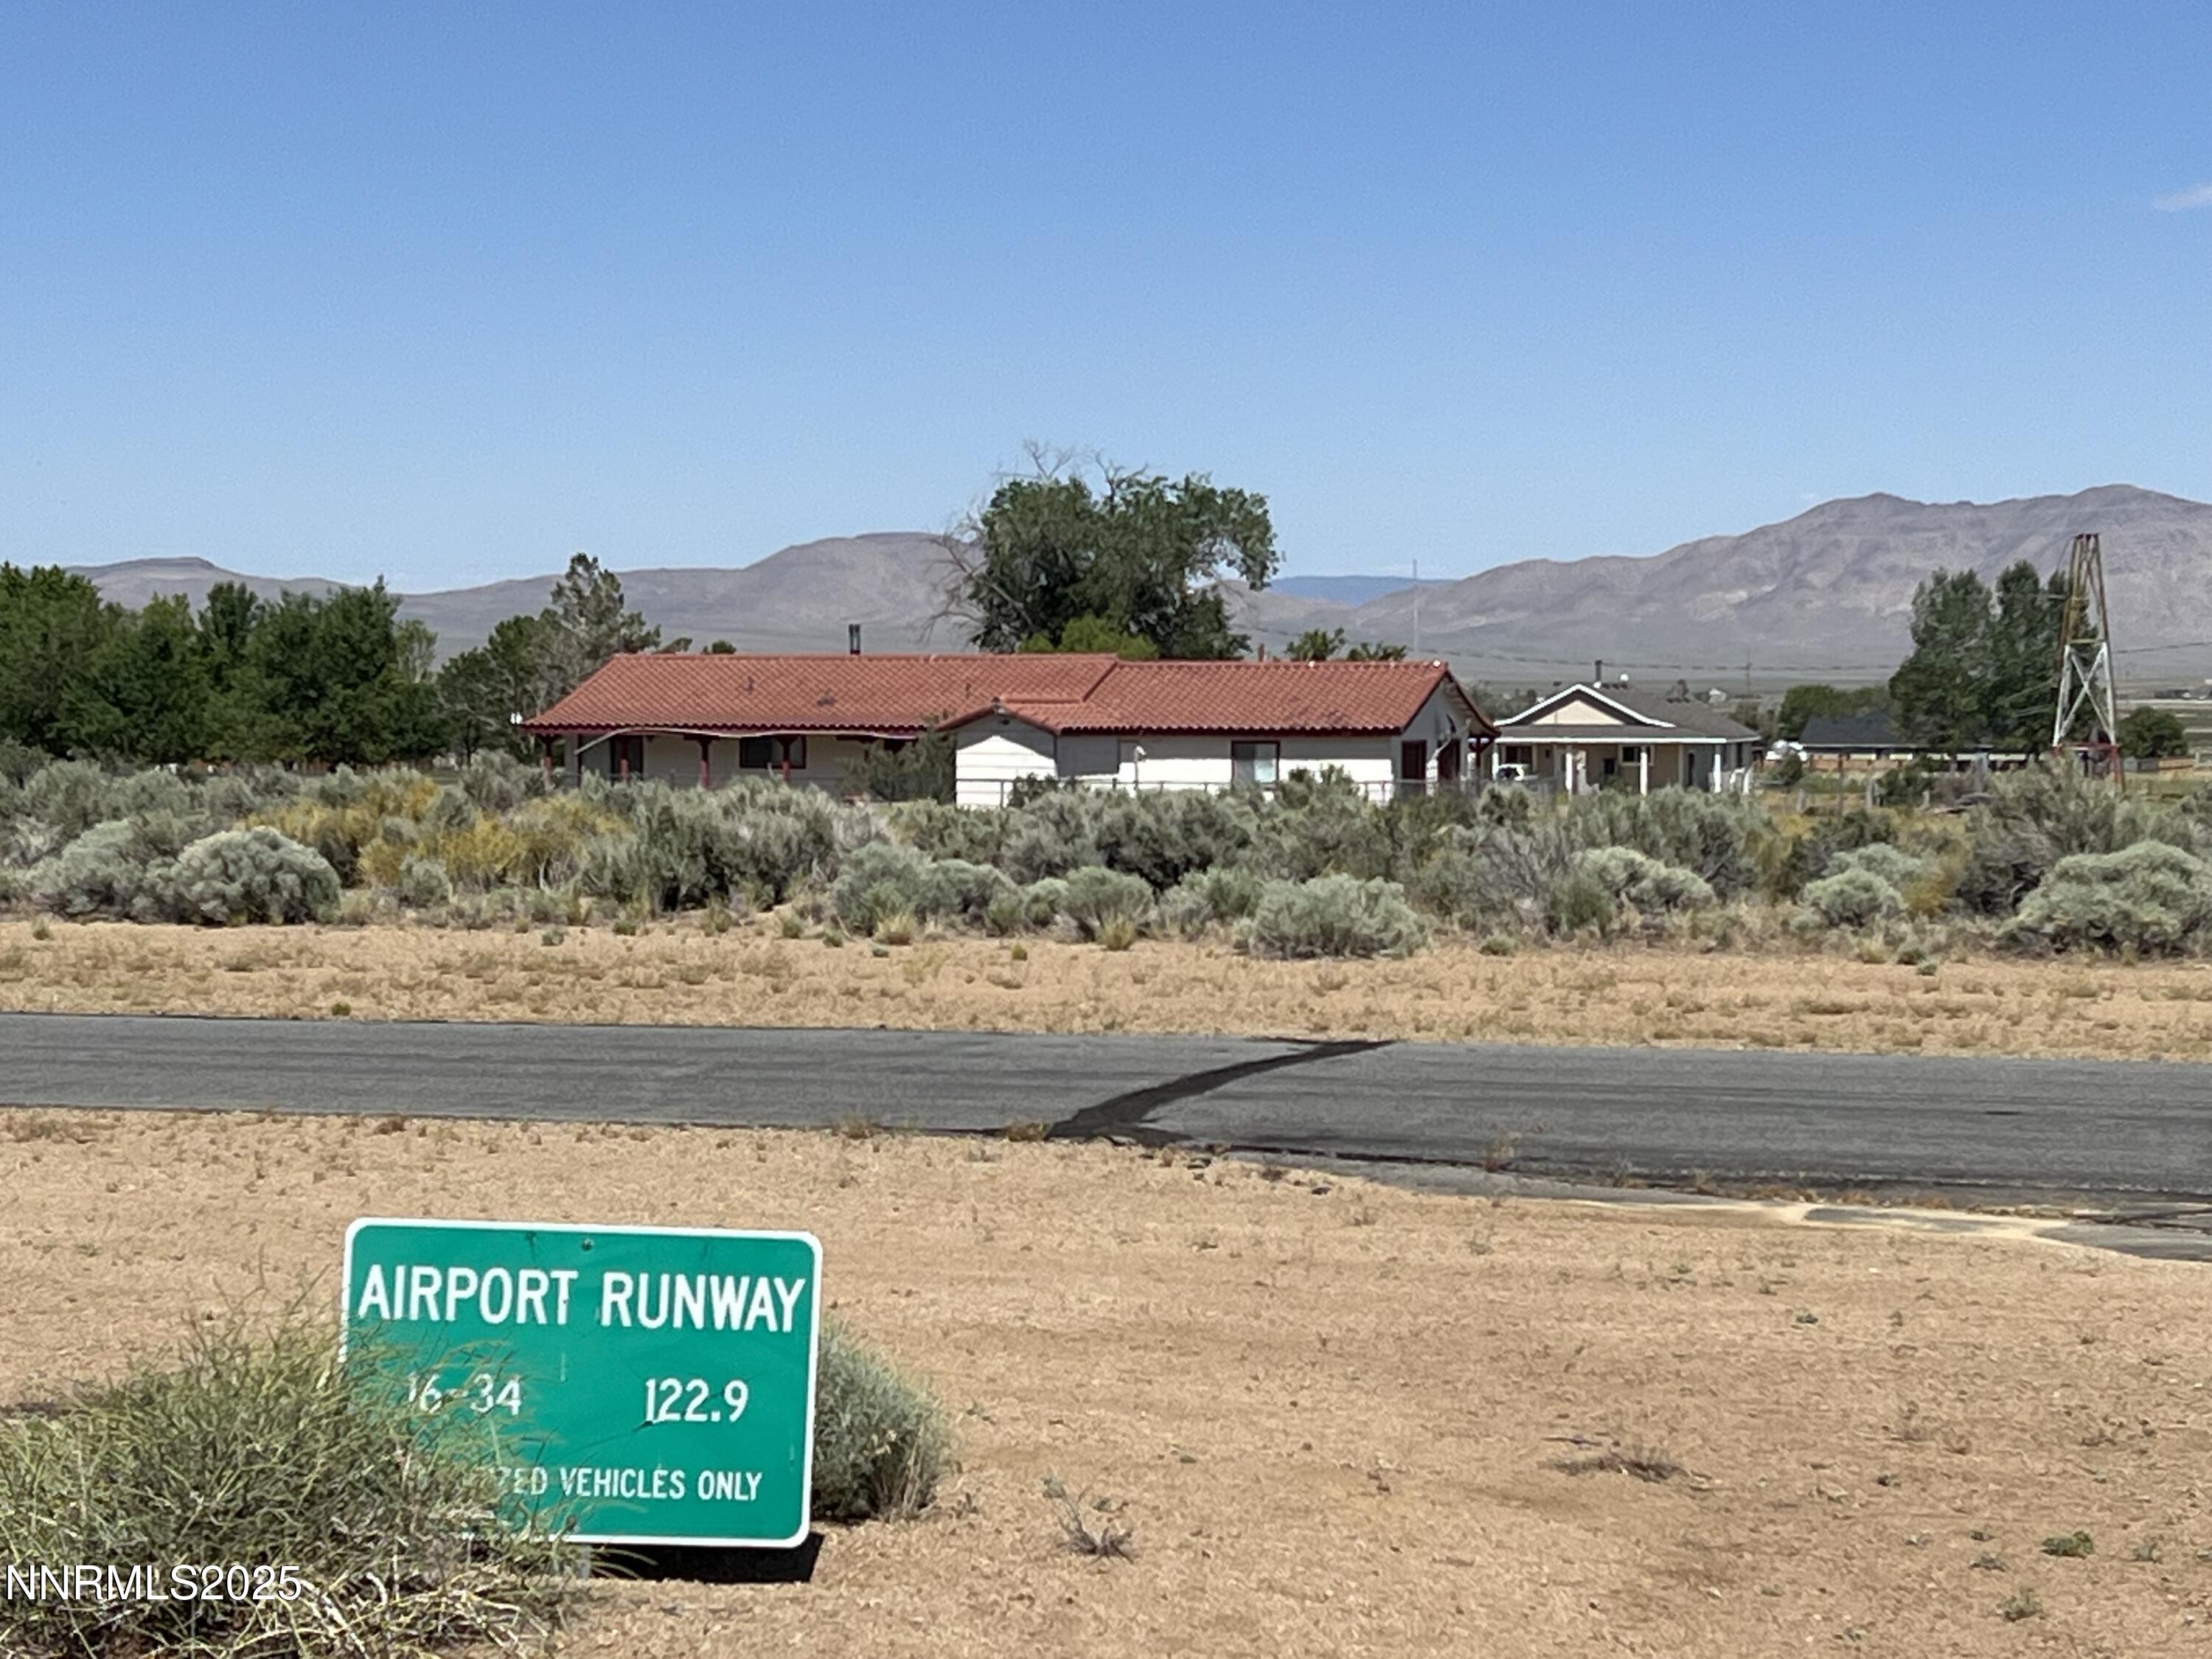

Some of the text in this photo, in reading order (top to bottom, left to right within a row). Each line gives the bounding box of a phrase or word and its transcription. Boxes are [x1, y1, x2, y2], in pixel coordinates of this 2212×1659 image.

[358, 1264, 806, 1333] AIRPORT RUNWAY
[645, 1377, 749, 1424] 122.9
[559, 1467, 686, 1499] VEHICLES
[698, 1470, 763, 1501] ONLY
